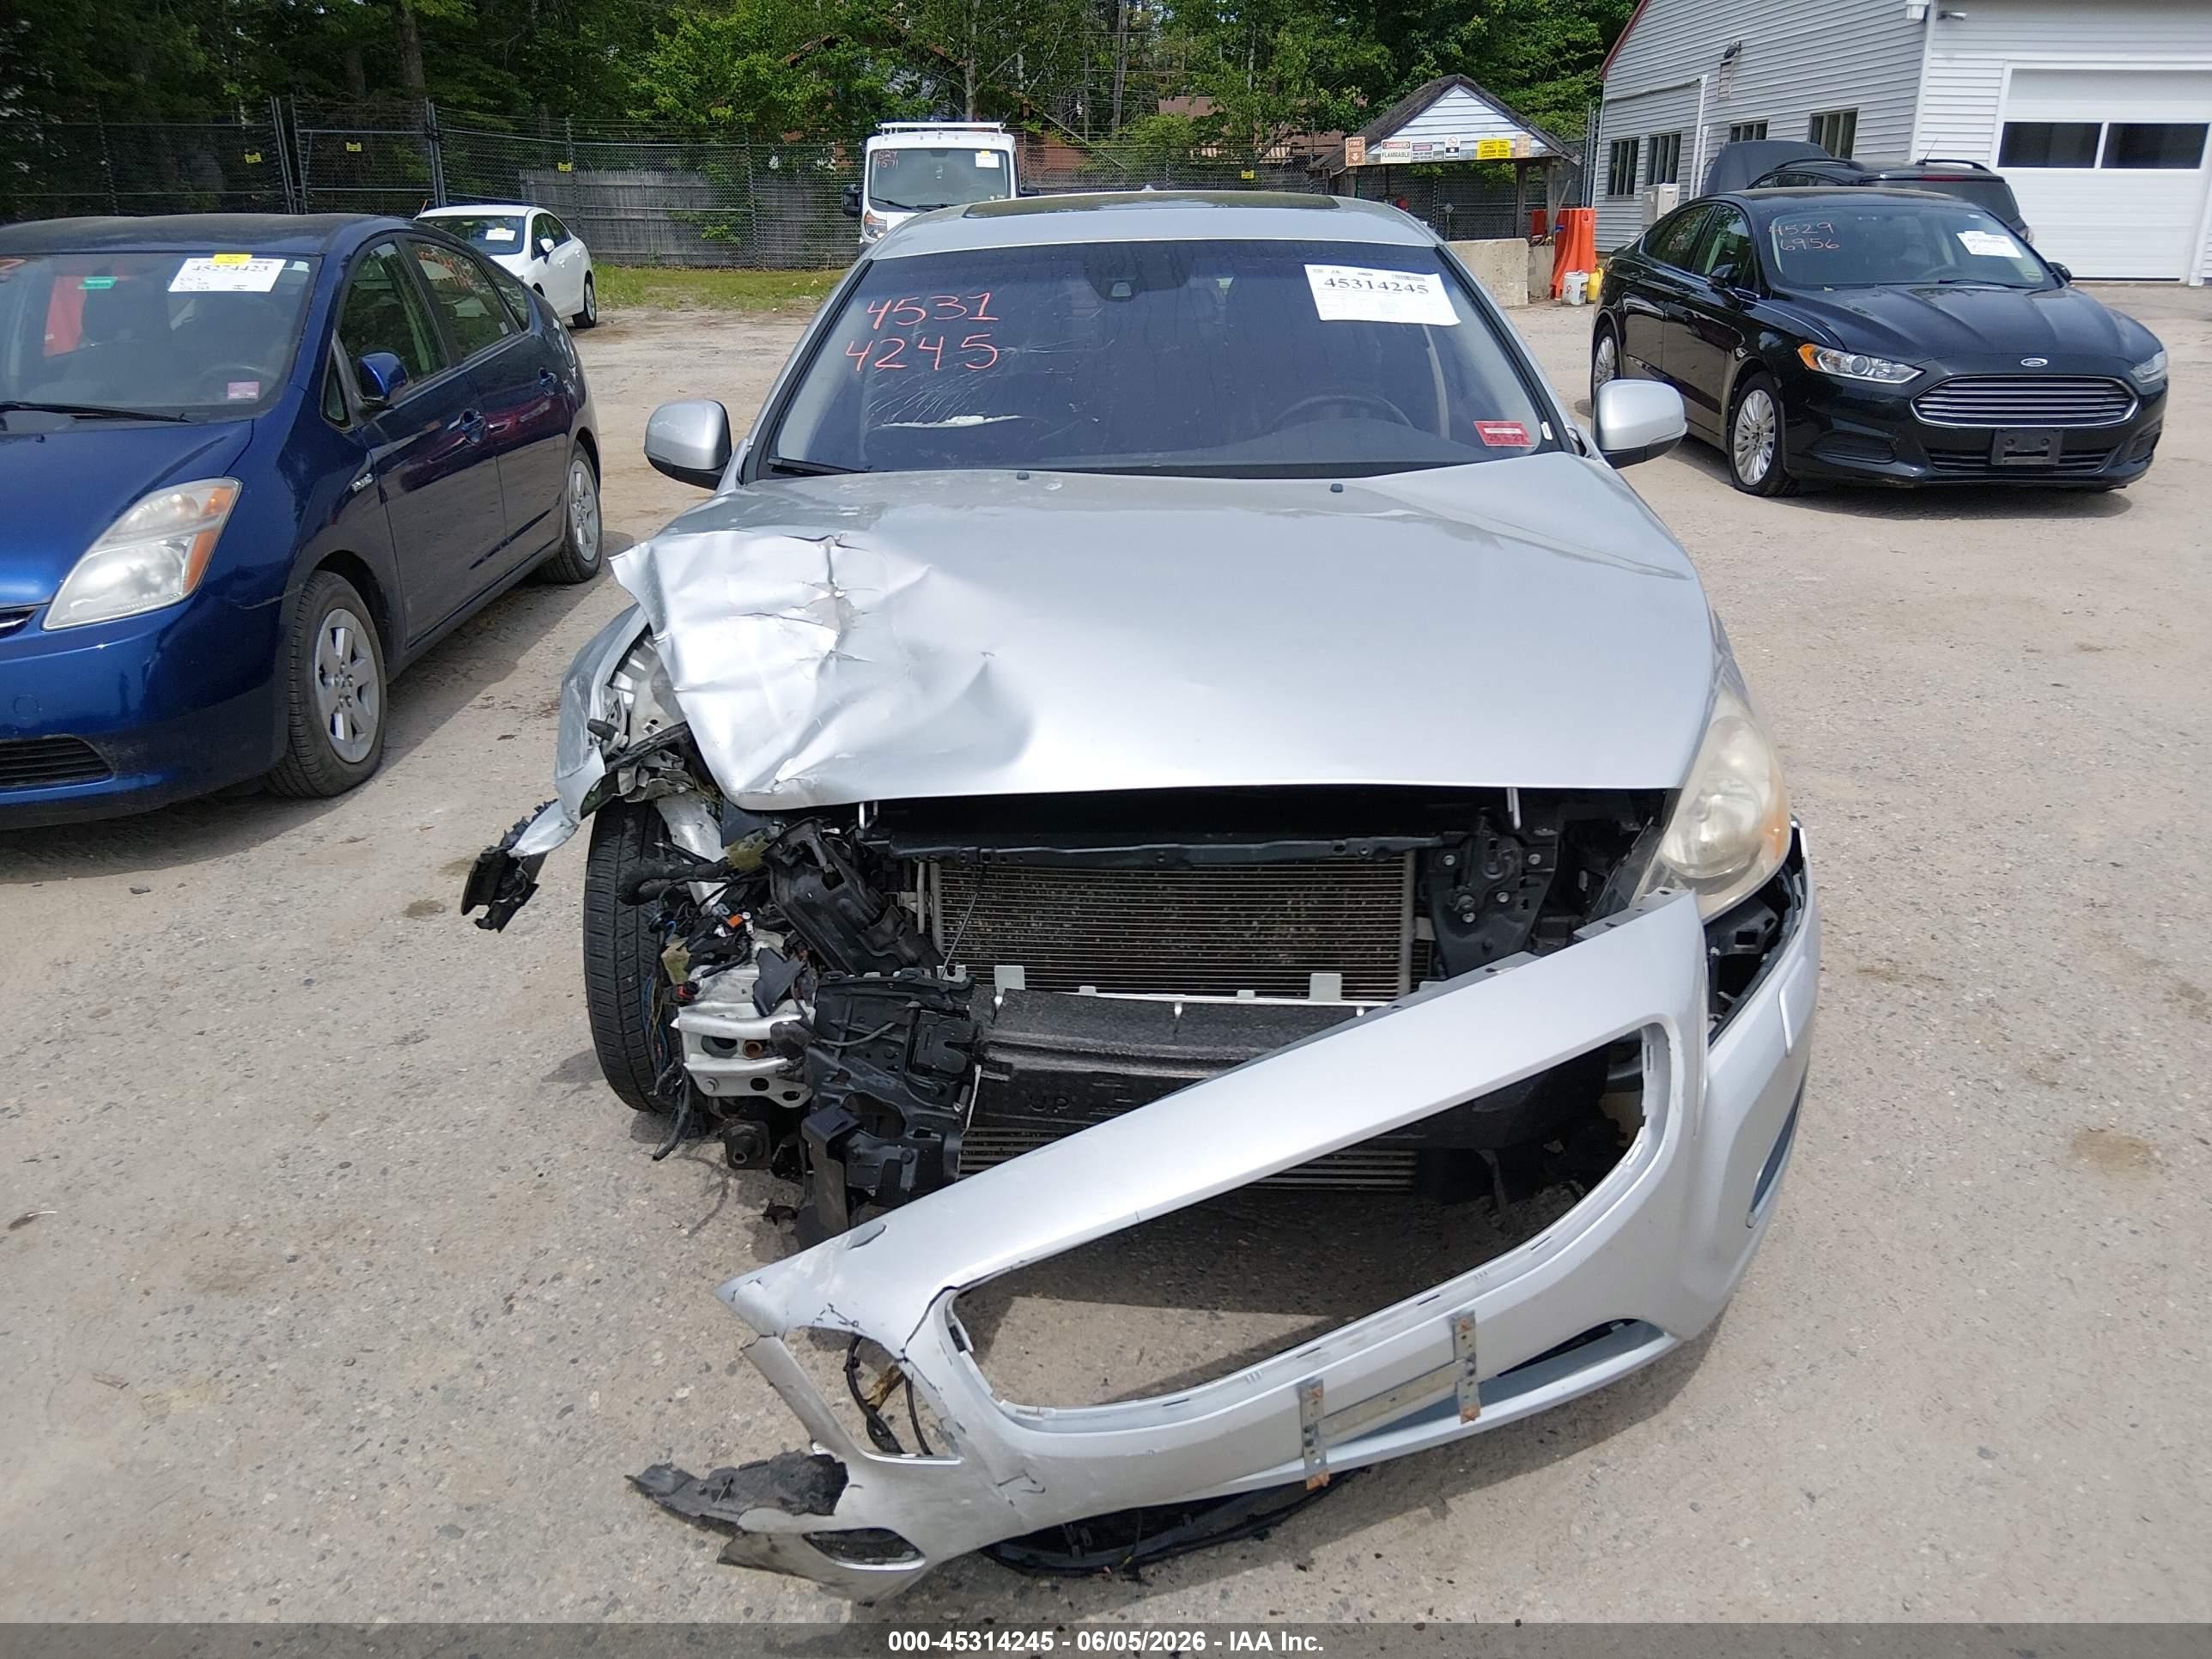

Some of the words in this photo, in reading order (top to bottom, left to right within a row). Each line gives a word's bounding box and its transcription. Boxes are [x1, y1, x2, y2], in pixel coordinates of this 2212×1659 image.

[1768, 222, 1834, 236] 4529
[1780, 238, 1840, 251] 6956
[1323, 277, 1430, 295] 45314245
[866, 292, 1000, 330] 4531
[845, 333, 999, 372] 4245
